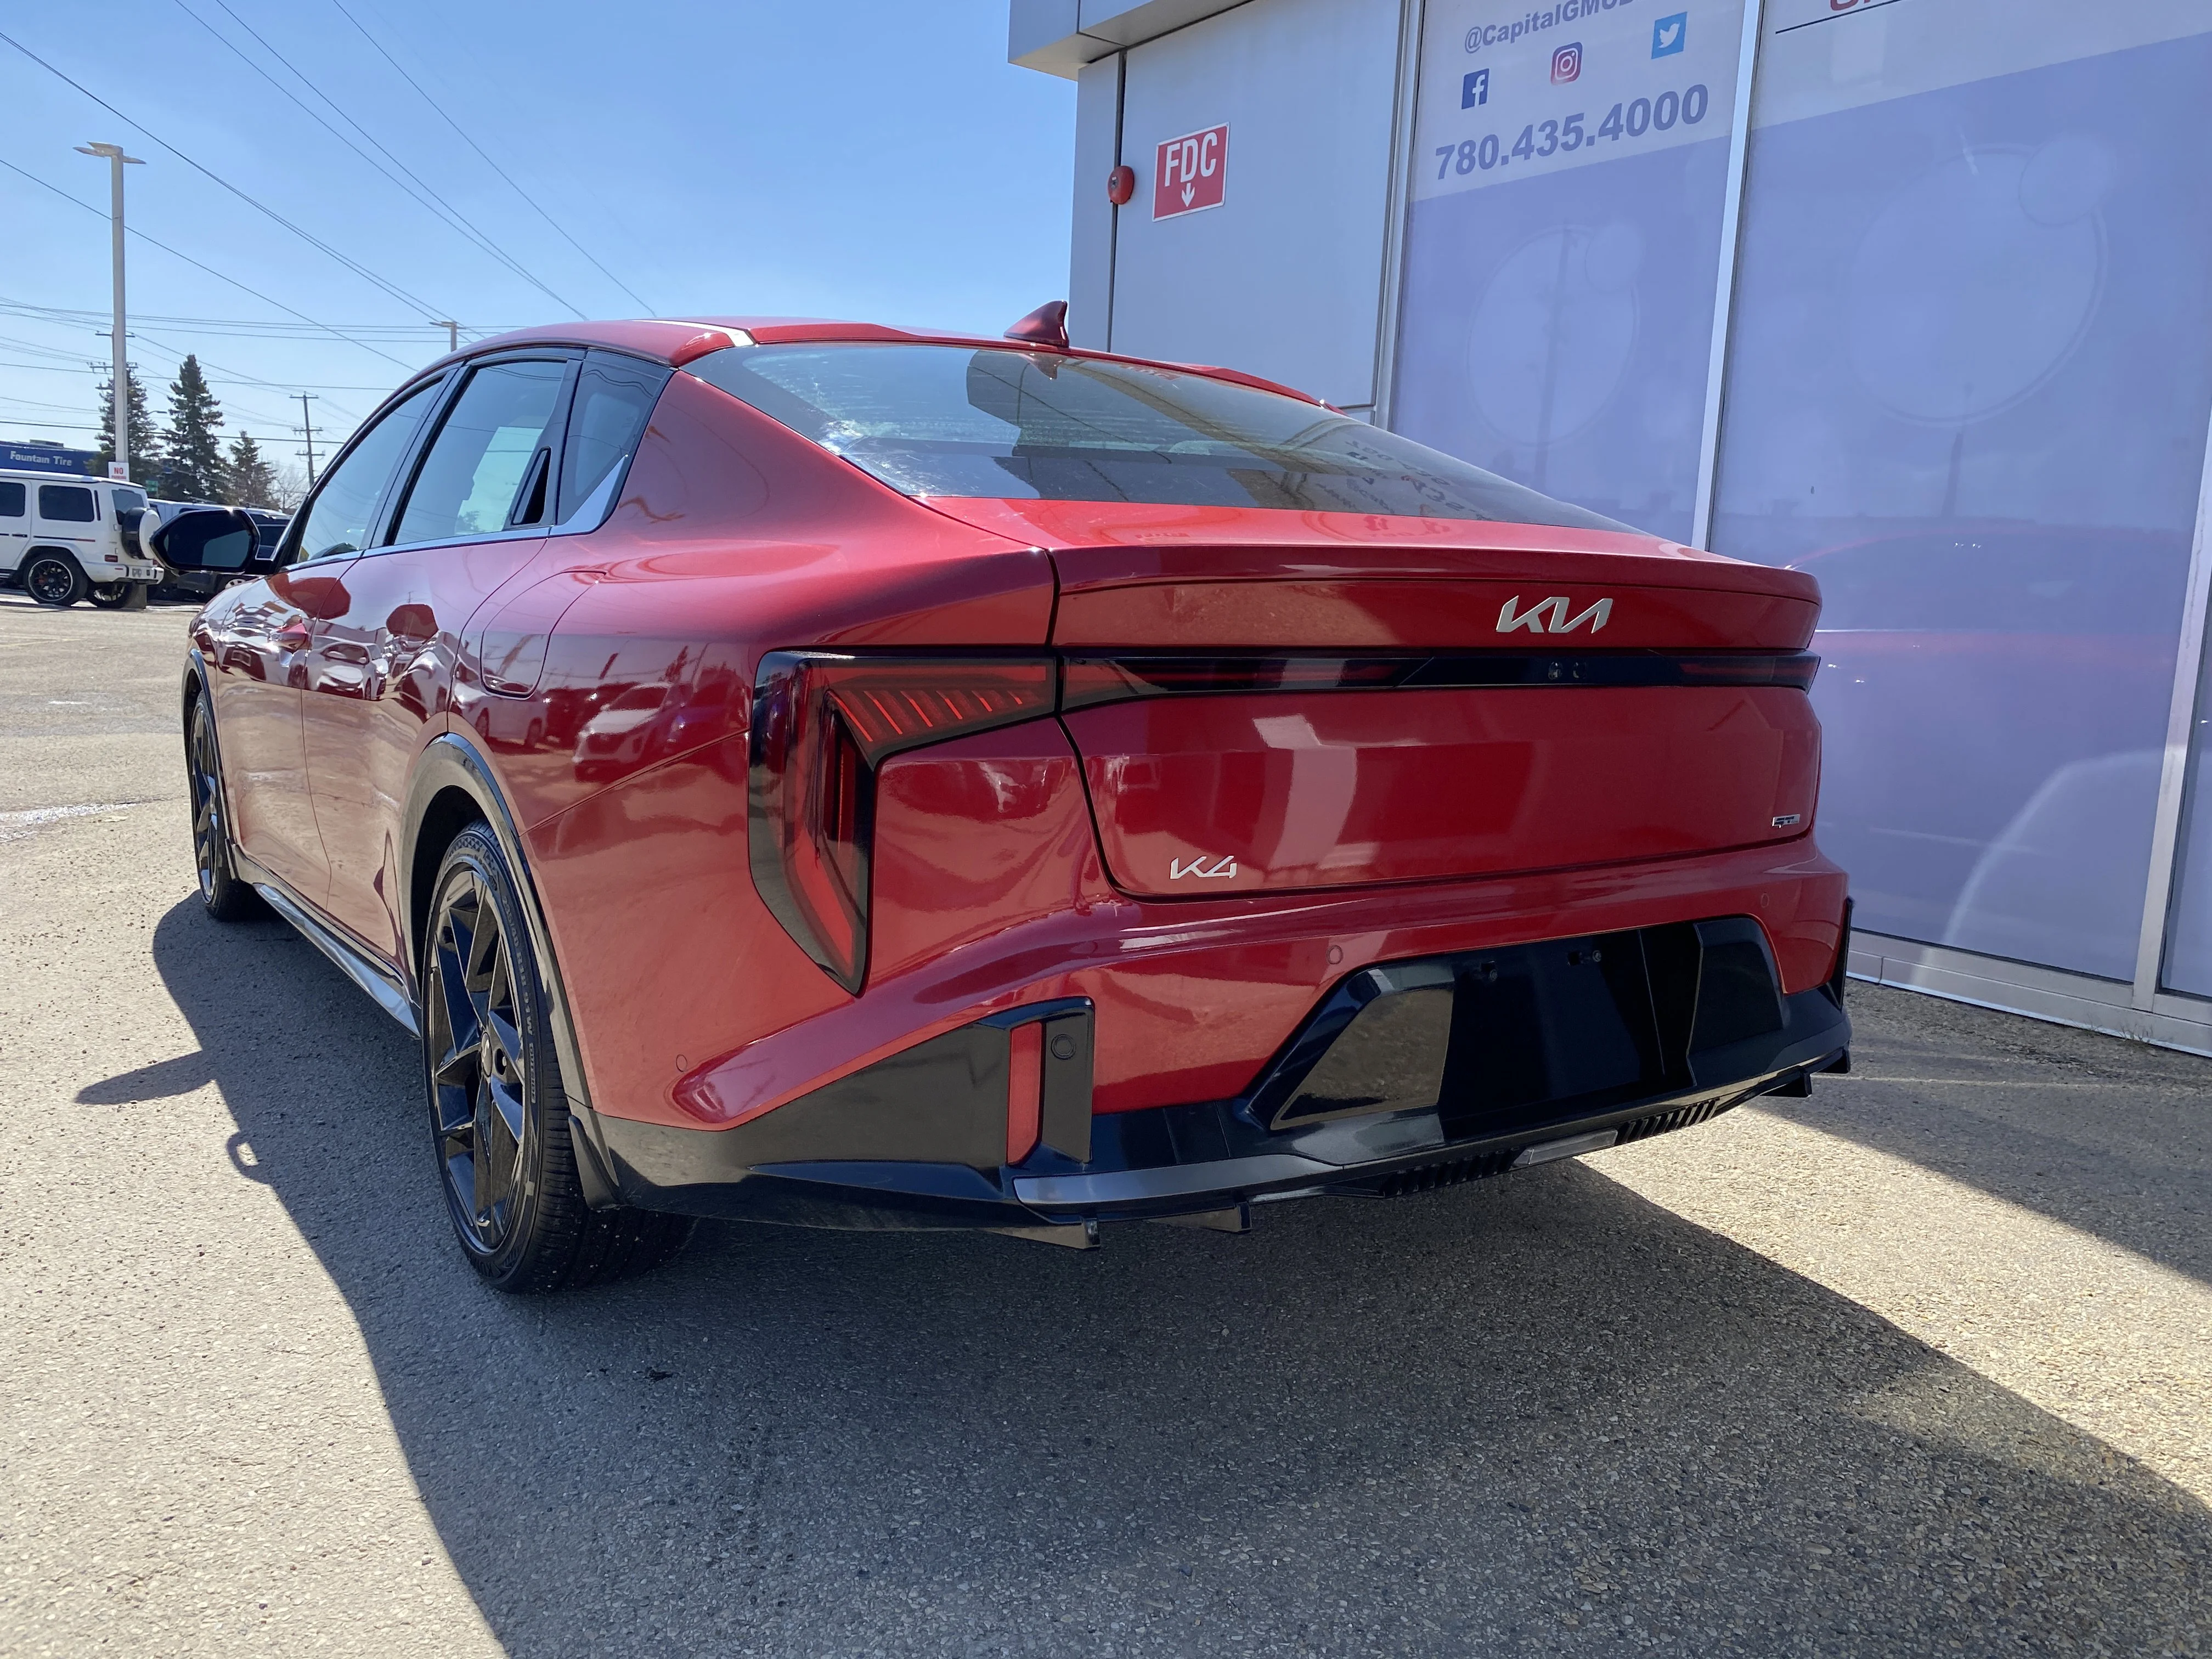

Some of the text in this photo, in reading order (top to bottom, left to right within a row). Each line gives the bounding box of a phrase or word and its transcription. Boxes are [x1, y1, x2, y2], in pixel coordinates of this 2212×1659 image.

[1465, 0, 1633, 54] @CapitalGM
[1435, 84, 1708, 180] 780.435.4000
[1165, 132, 1217, 187] FDC
[10, 450, 72, 466] Fountain Tire
[1170, 855, 1238, 879] K4
